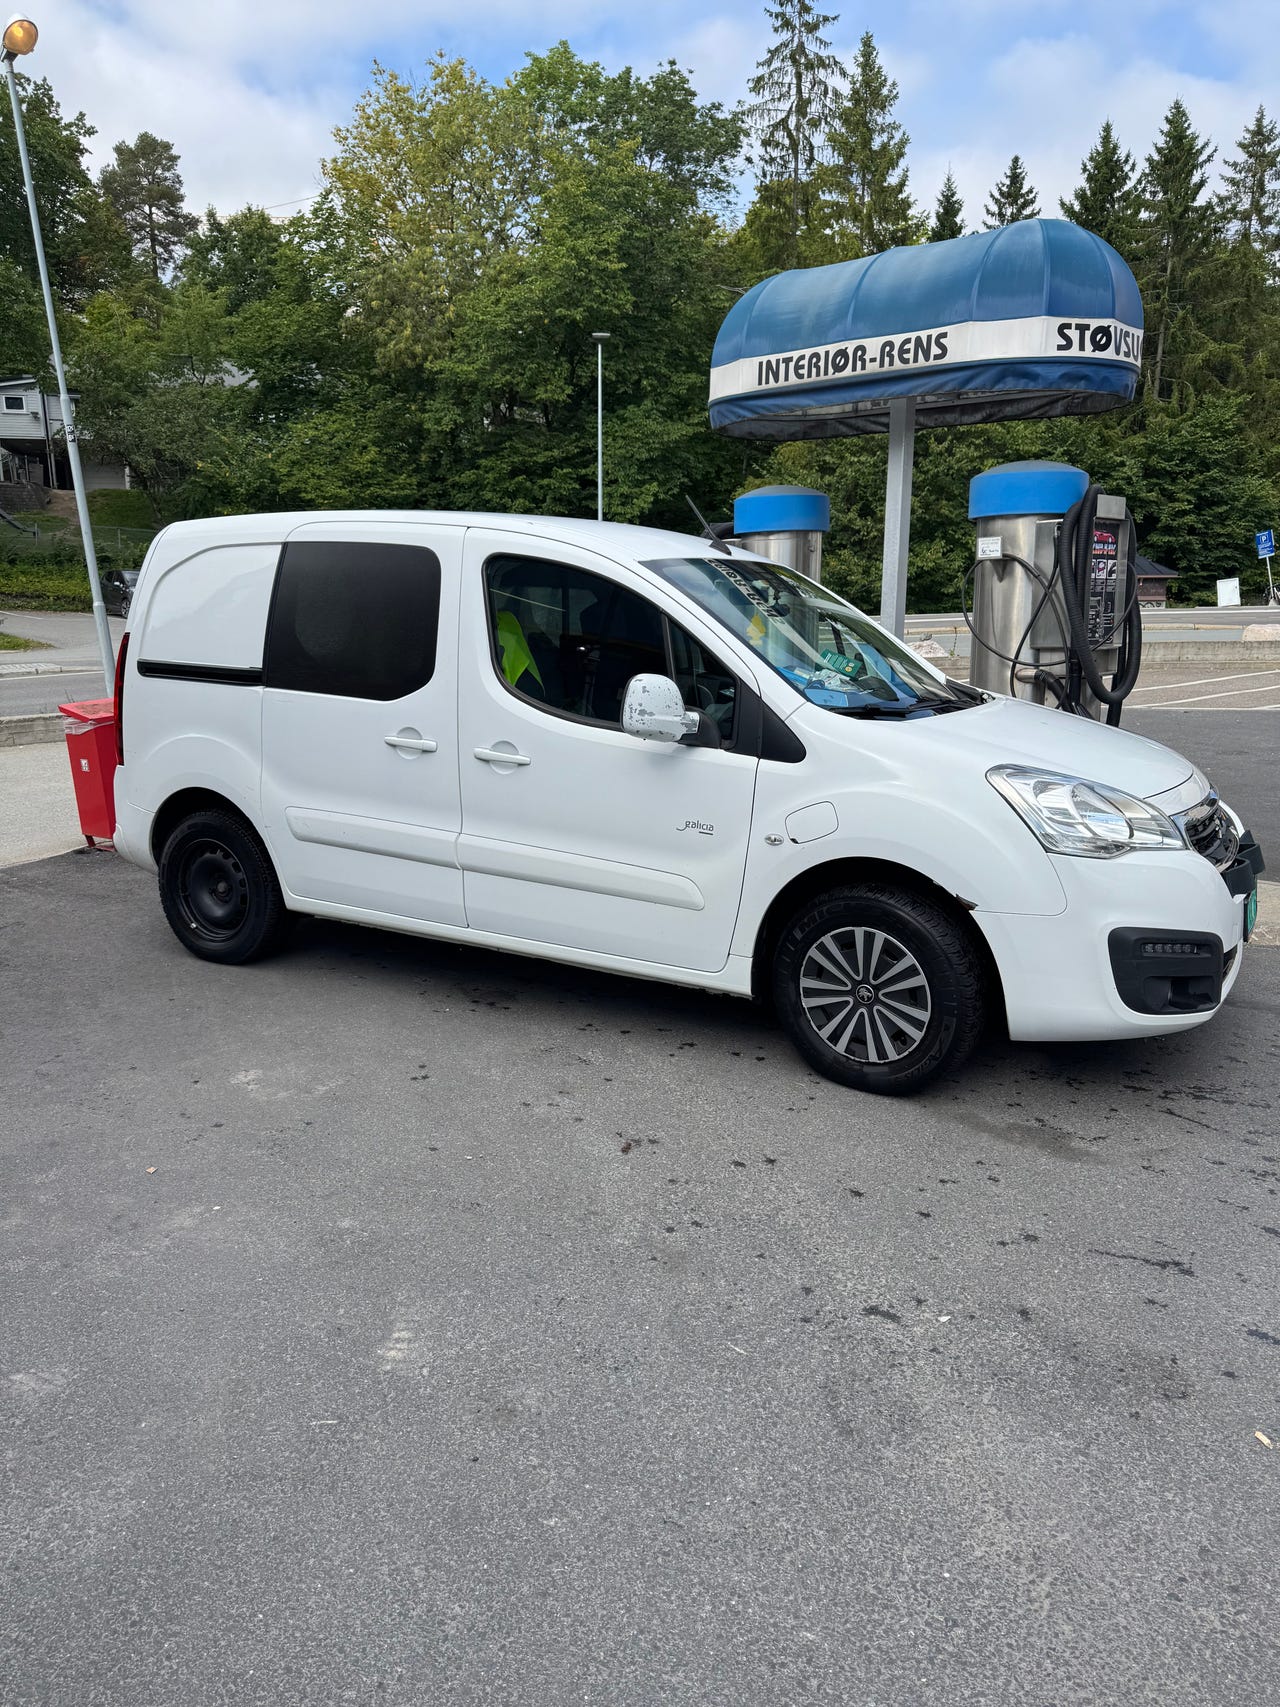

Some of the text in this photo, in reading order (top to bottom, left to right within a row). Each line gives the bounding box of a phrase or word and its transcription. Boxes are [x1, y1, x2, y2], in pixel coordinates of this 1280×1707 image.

[757, 331, 949, 386] INTERIØR-RENS
[1057, 322, 1143, 362] STØVSU
[676, 819, 714, 832] galicia
